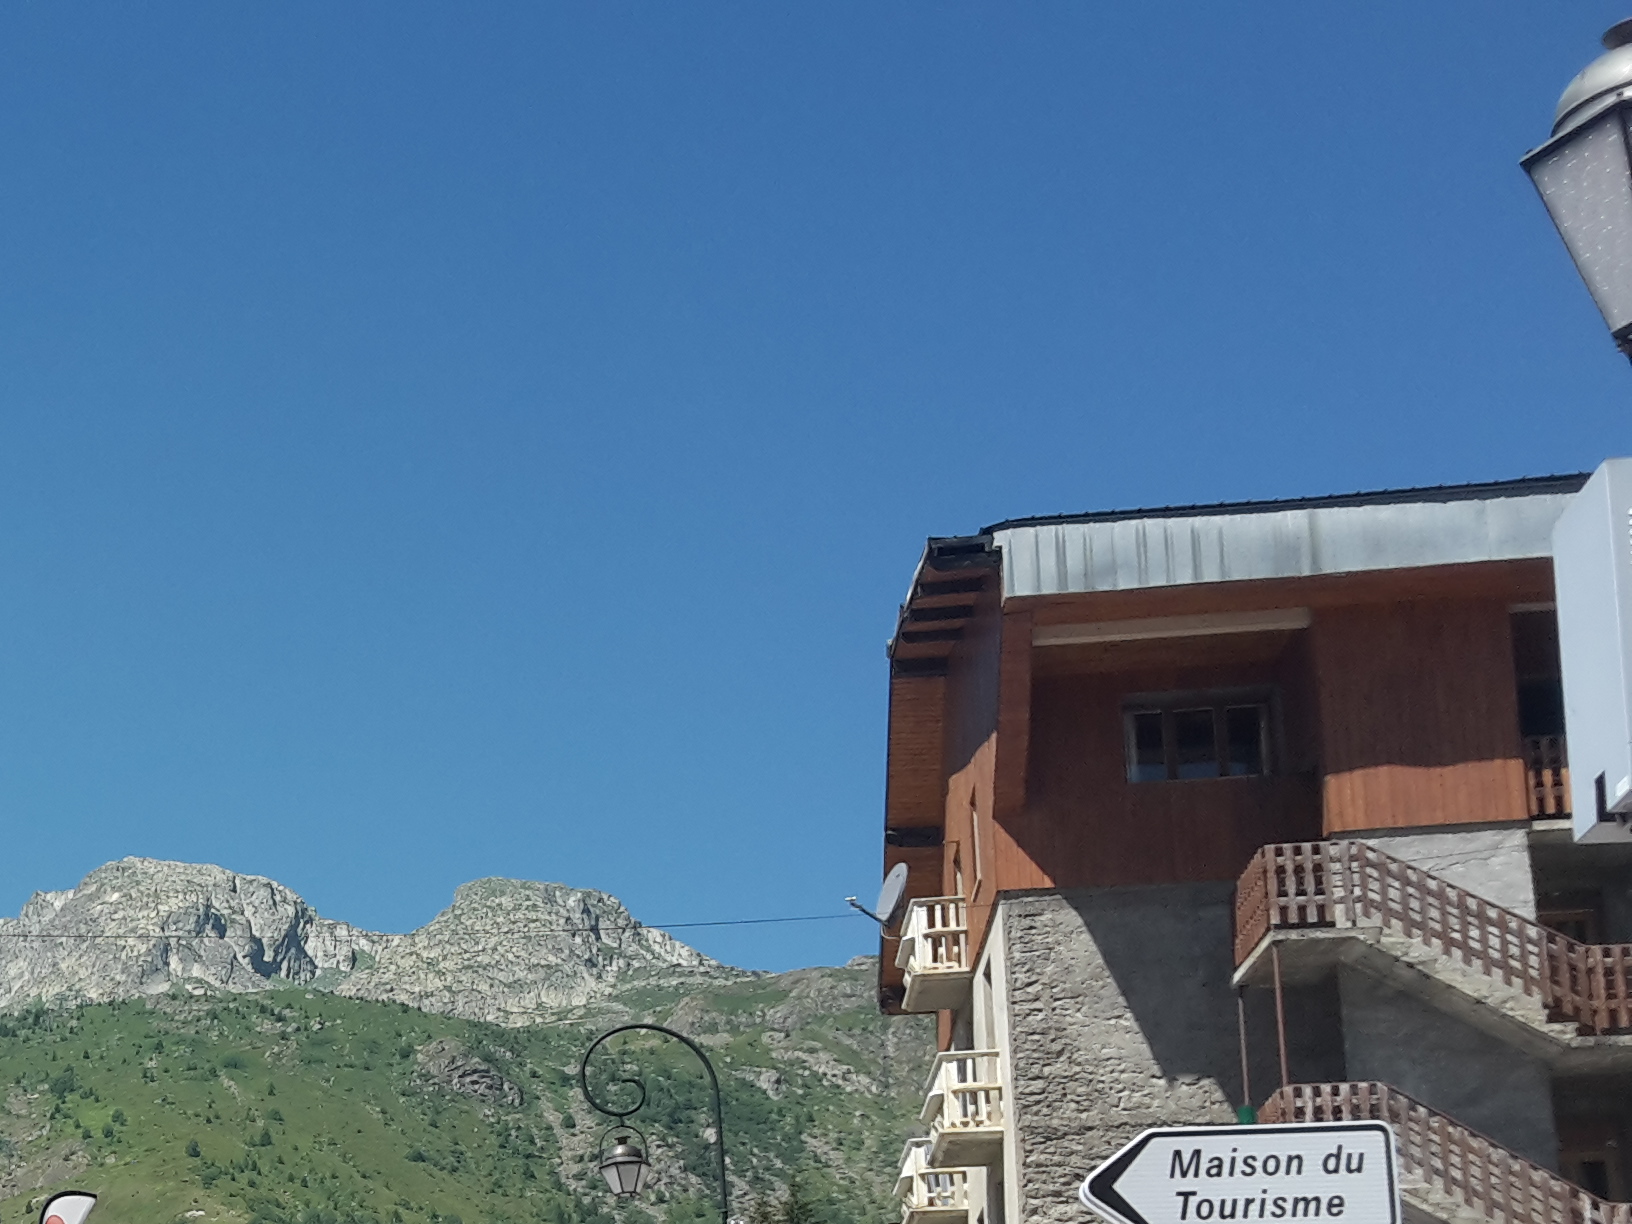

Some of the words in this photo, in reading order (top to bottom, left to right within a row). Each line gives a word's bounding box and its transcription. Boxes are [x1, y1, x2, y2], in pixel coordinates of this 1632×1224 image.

[1169, 1147, 1305, 1179] Maison
[1322, 1144, 1365, 1175] du
[1175, 1189, 1346, 1221] Tourisme
